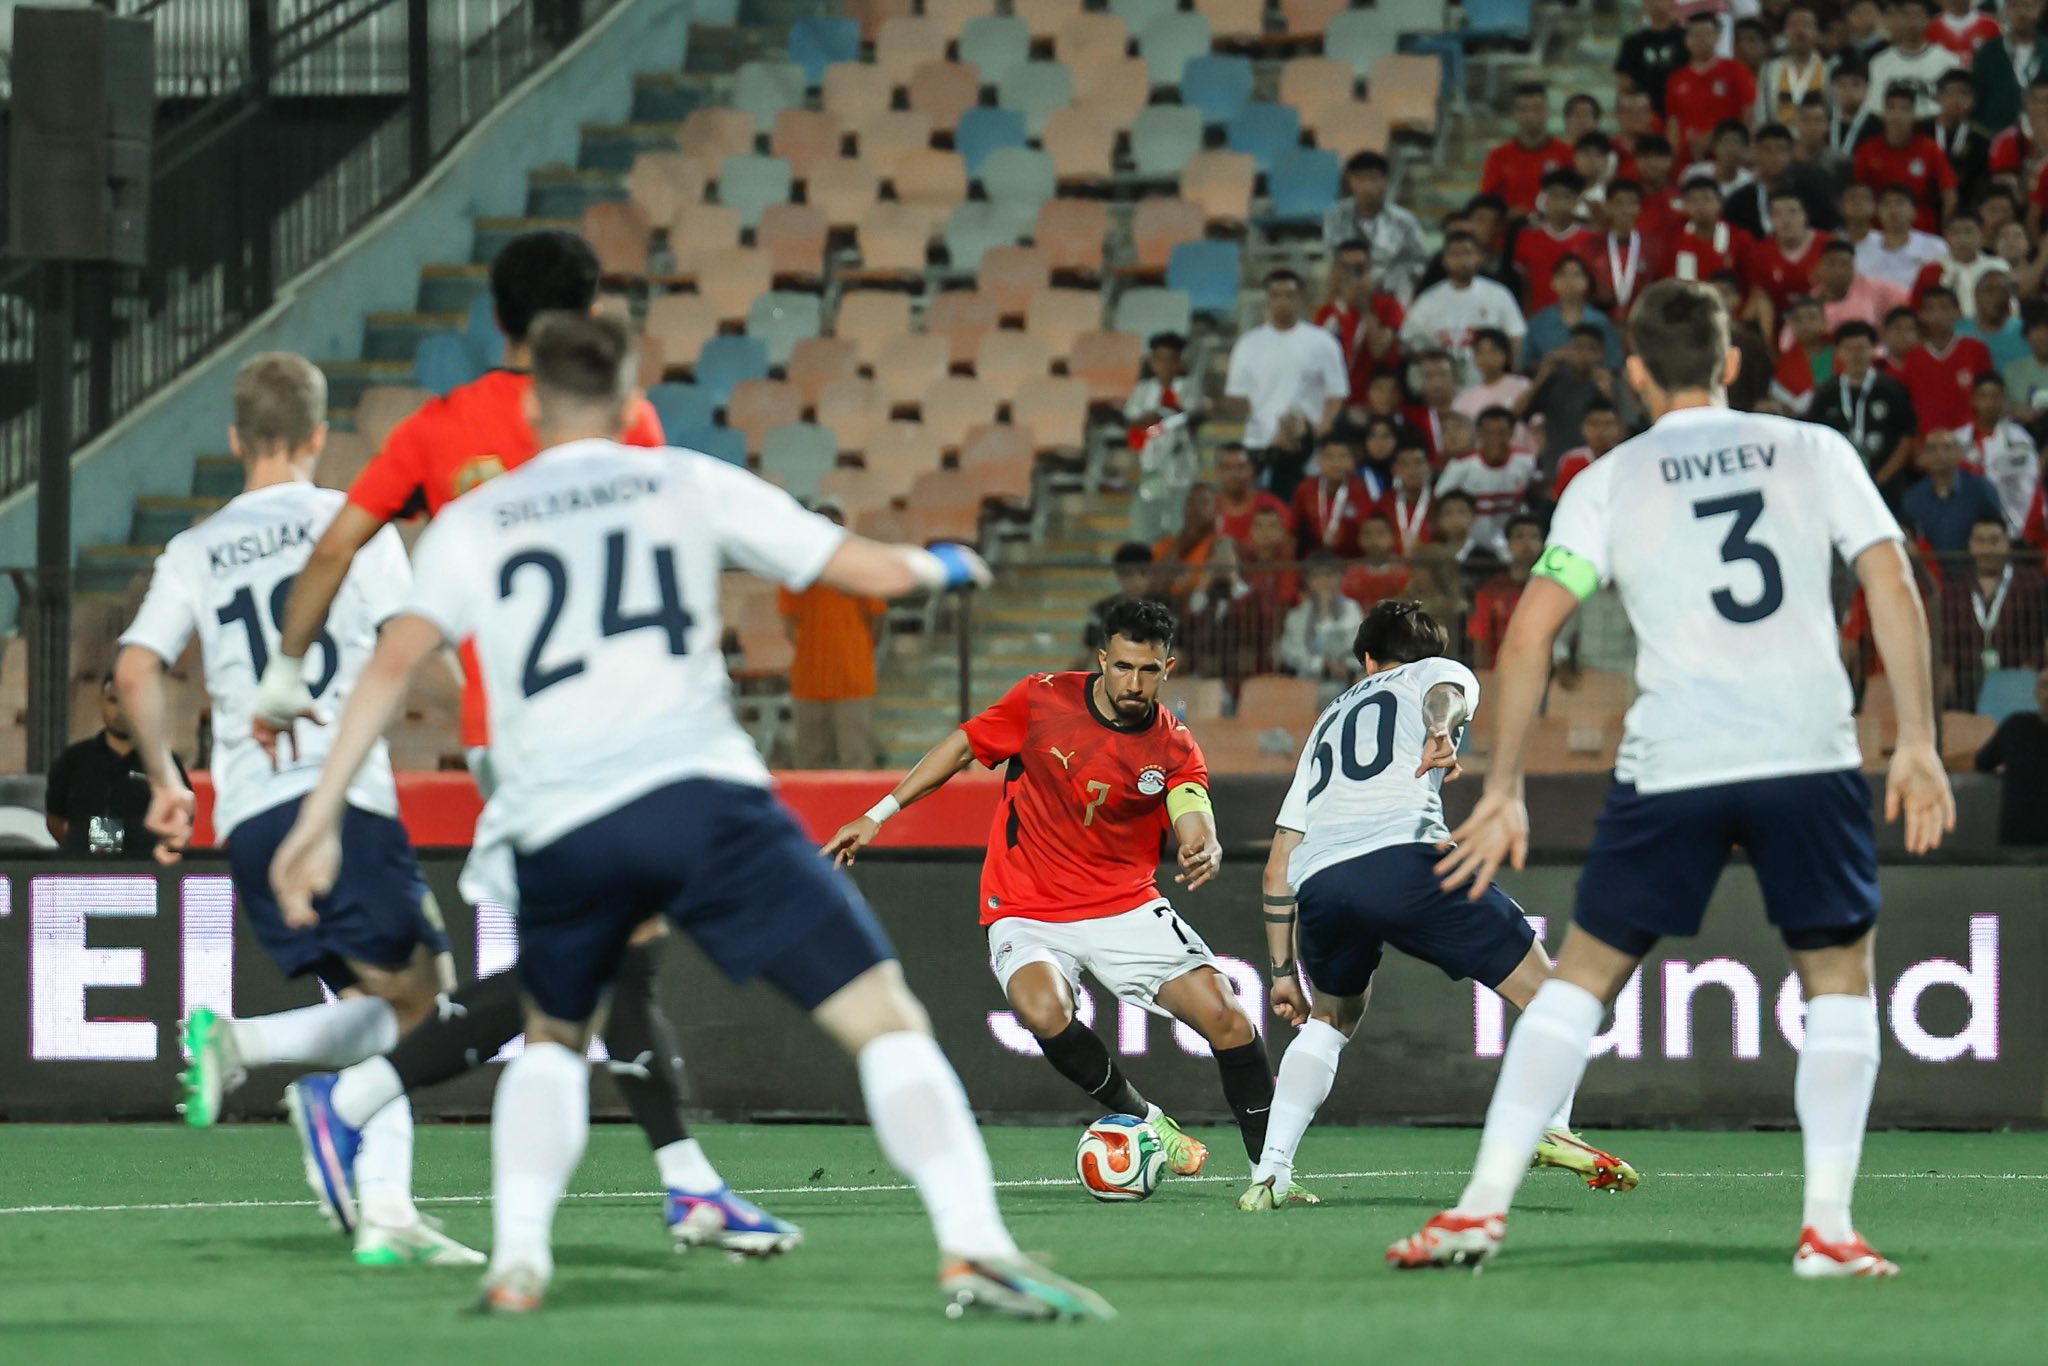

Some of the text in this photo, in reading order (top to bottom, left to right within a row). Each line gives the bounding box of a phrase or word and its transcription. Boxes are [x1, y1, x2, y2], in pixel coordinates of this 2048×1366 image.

[1659, 442, 1776, 484] DIVEEV
[1693, 488, 1784, 624] 3
[499, 527, 694, 698] 24
[1083, 778, 1112, 827] 7
[1152, 904, 1189, 945] 7
